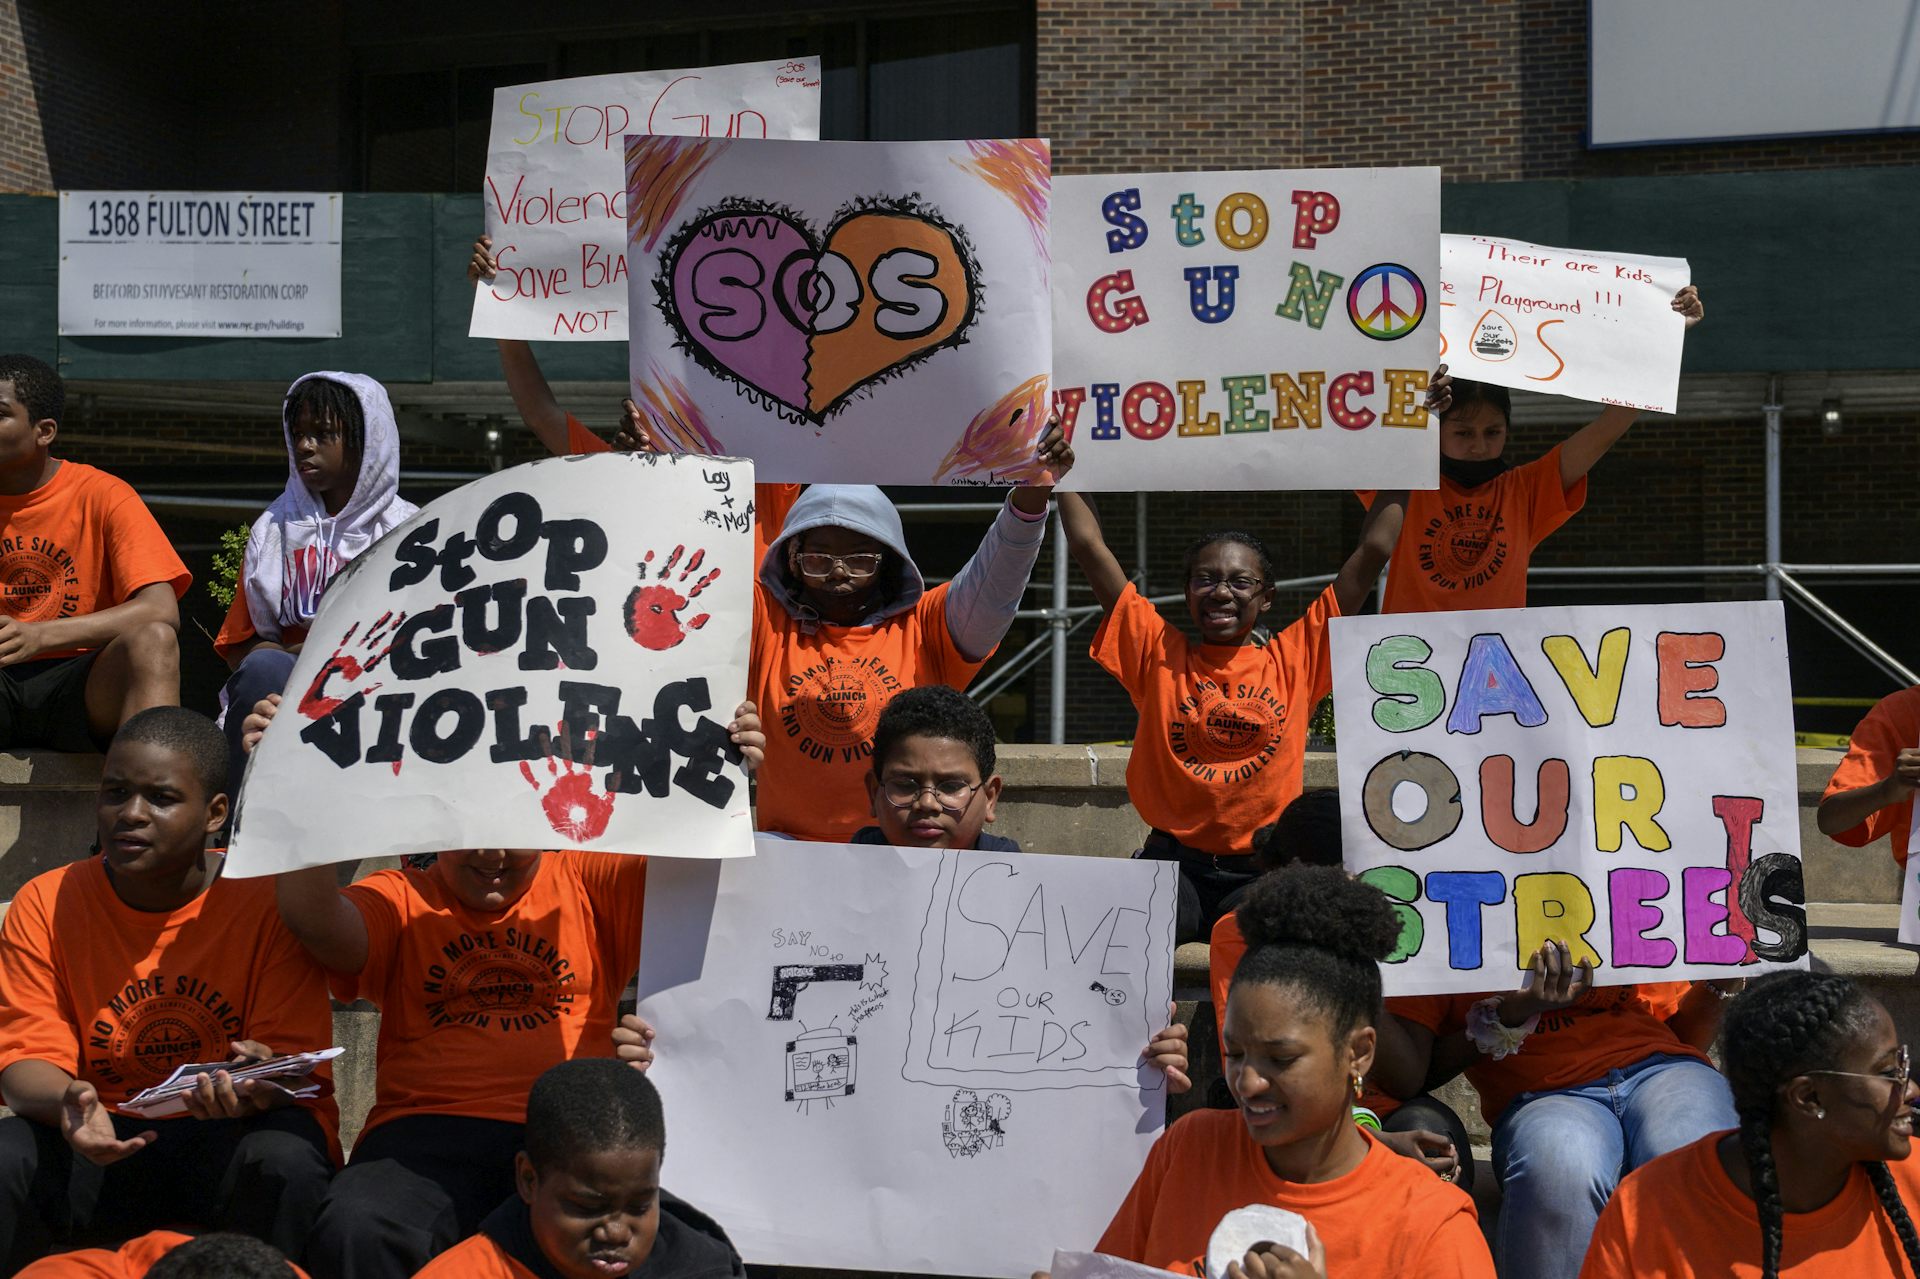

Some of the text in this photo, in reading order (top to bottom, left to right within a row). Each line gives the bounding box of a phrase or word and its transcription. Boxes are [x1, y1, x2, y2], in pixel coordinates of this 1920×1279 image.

[88, 200, 315, 237] 1368 FULTON STREET
[487, 175, 627, 225] Violenc
[491, 245, 571, 301] Save
[1477, 243, 1653, 284] Their are Kids
[143, 284, 207, 300] STUYVESANT
[210, 284, 278, 300] RESTORATION
[281, 284, 309, 300] CORP
[692, 247, 948, 342] SOS
[1086, 261, 1345, 333] GUN
[1478, 276, 1581, 315] Playground
[94, 319, 107, 328] For
[108, 320, 127, 328] more
[554, 310, 618, 335] NOT
[702, 468, 730, 492] Lay
[1425, 518, 1442, 537] NO
[31, 537, 79, 586] SILENCE
[1420, 544, 1435, 571] END
[1463, 541, 1507, 590] VIOLENCE
[4, 585, 52, 596] LAUNCH
[388, 578, 598, 681] GUN
[816, 691, 867, 702] LAUNCH
[1366, 627, 1727, 735] SAVE
[300, 677, 744, 809] VIOLENCE
[781, 705, 801, 737] END
[800, 737, 834, 764] GUN
[1206, 717, 1261, 732] LAUNCH
[1171, 721, 1281, 783] END GUN VIOLENC
[1362, 749, 1672, 854] OUR
[771, 928, 811, 948] SAY
[952, 861, 1147, 982] SAVE
[424, 965, 447, 994] NO
[442, 931, 499, 962] MORE
[506, 928, 576, 986] SILENCE
[810, 945, 829, 957] NO
[90, 975, 243, 1050] NO MORE SILENCE
[996, 986, 1055, 1015] OUR
[134, 1040, 202, 1057] LAUNCH
[944, 1010, 1092, 1064] KIDS
[91, 1059, 124, 1085] END
